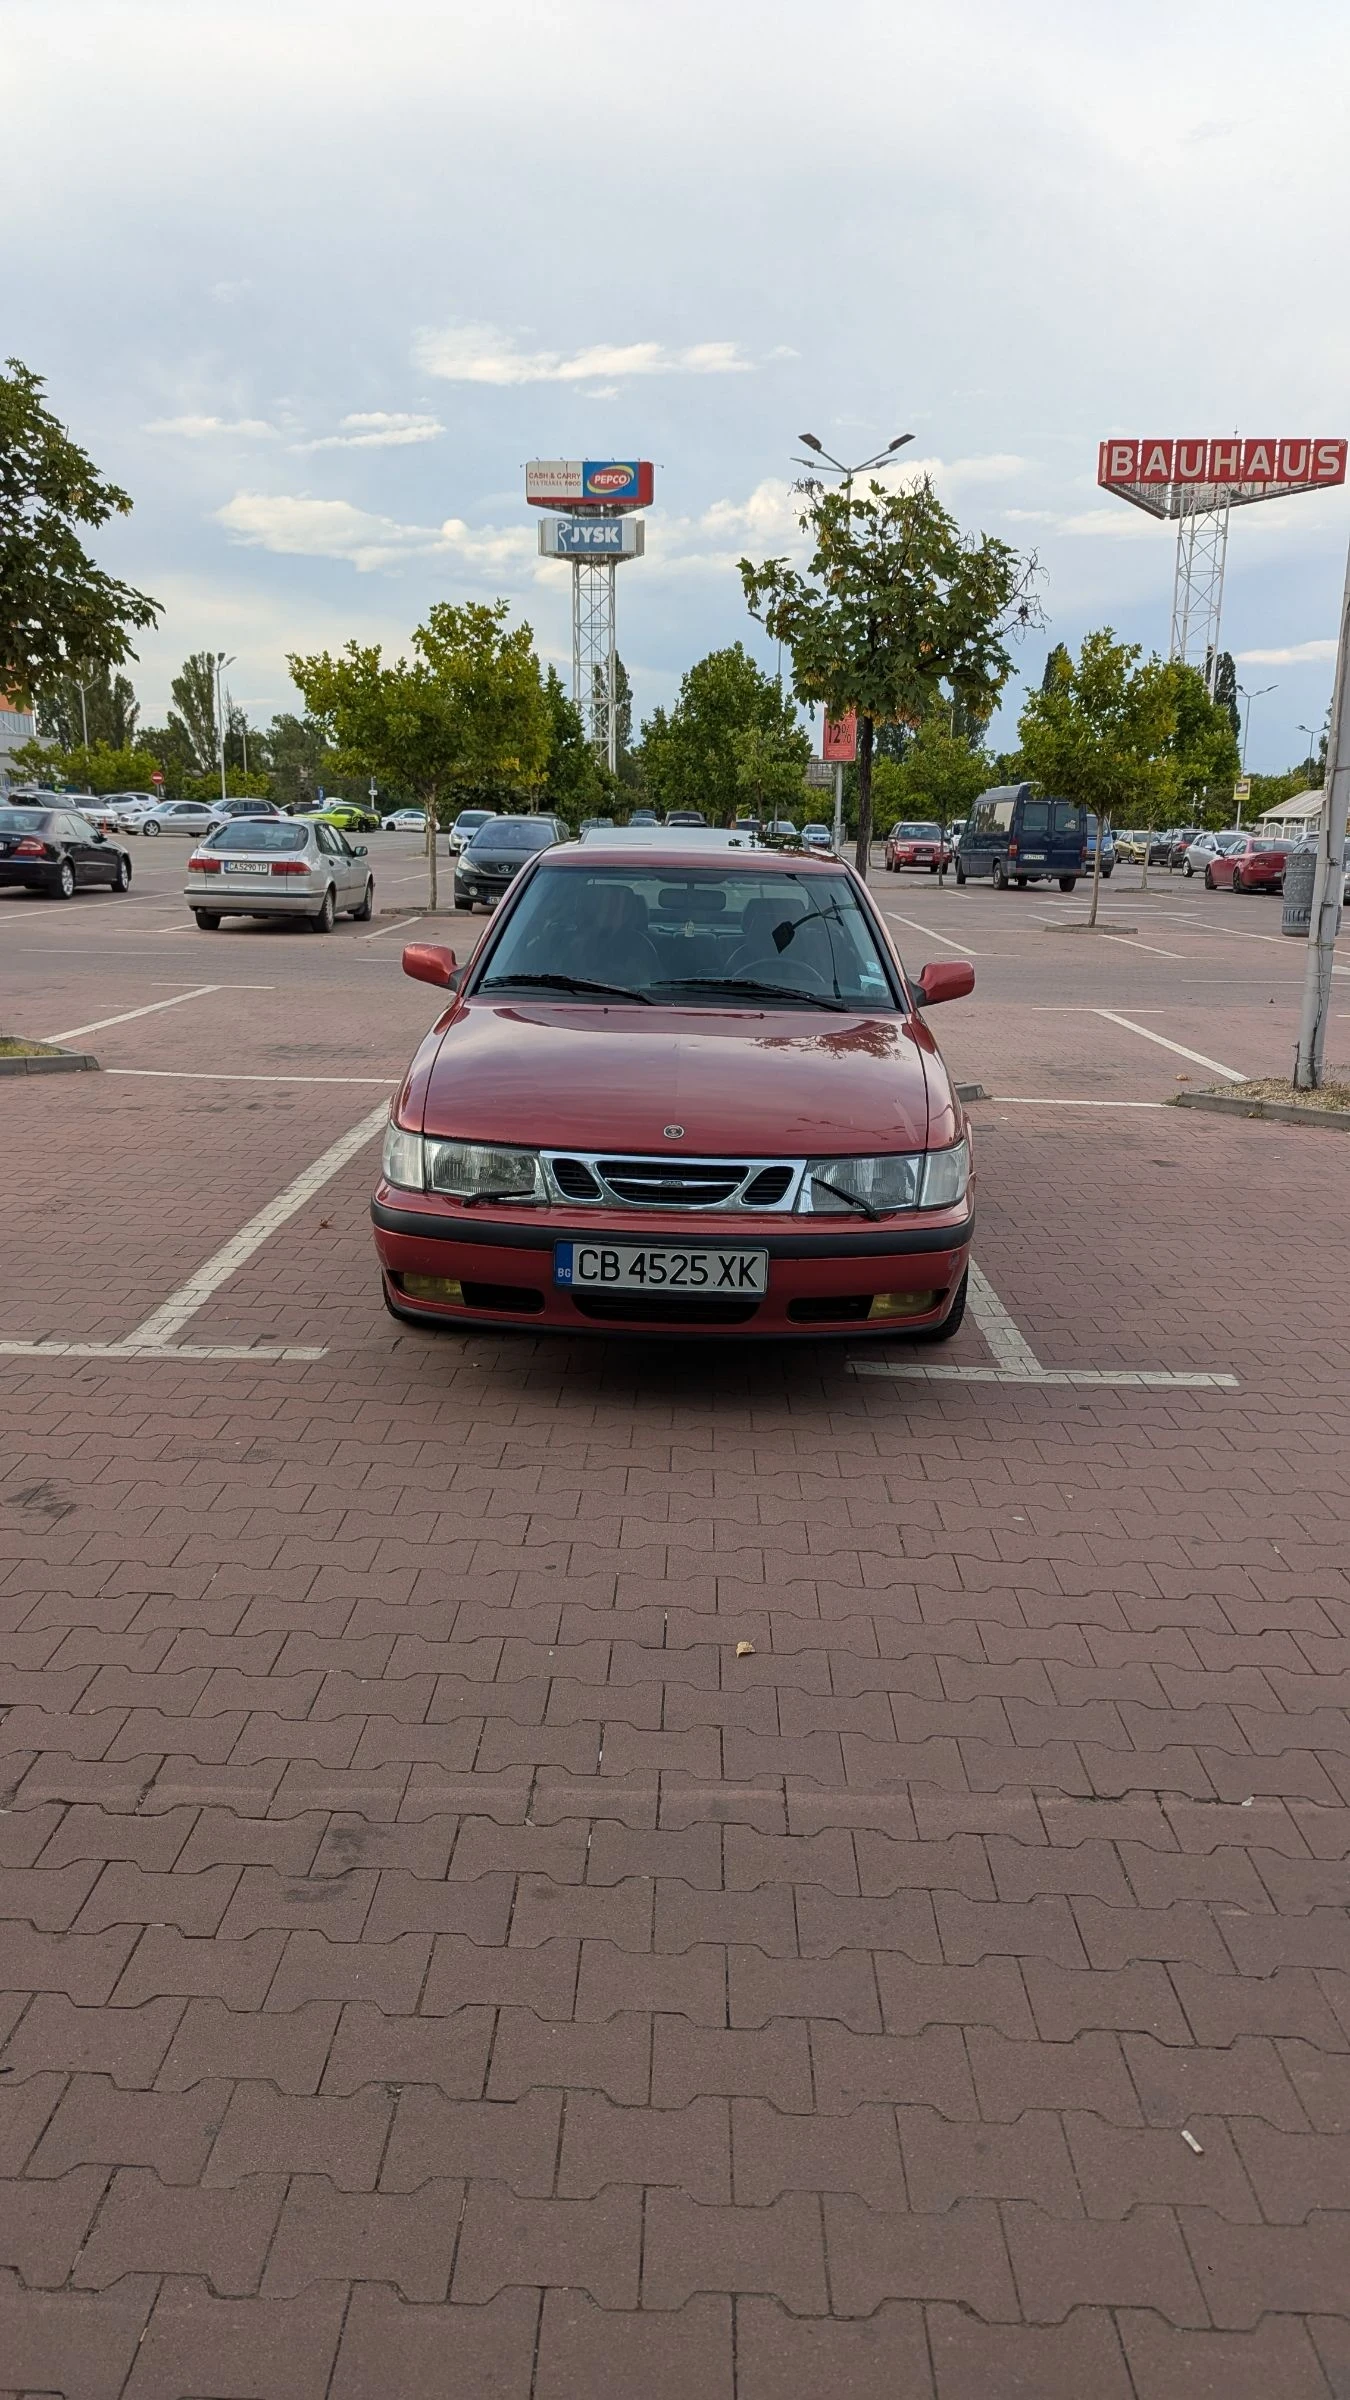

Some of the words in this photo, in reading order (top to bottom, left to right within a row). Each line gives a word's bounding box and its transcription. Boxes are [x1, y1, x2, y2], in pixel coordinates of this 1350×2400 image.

[1110, 445, 1340, 477] BAUHAUS
[594, 474, 627, 485] PEPCO
[570, 526, 619, 544] JYSK
[828, 723, 852, 744] 12%
[557, 1267, 572, 1279] BG
[578, 1249, 620, 1282] CB
[628, 1252, 709, 1286] 4525
[717, 1255, 759, 1288] XK
